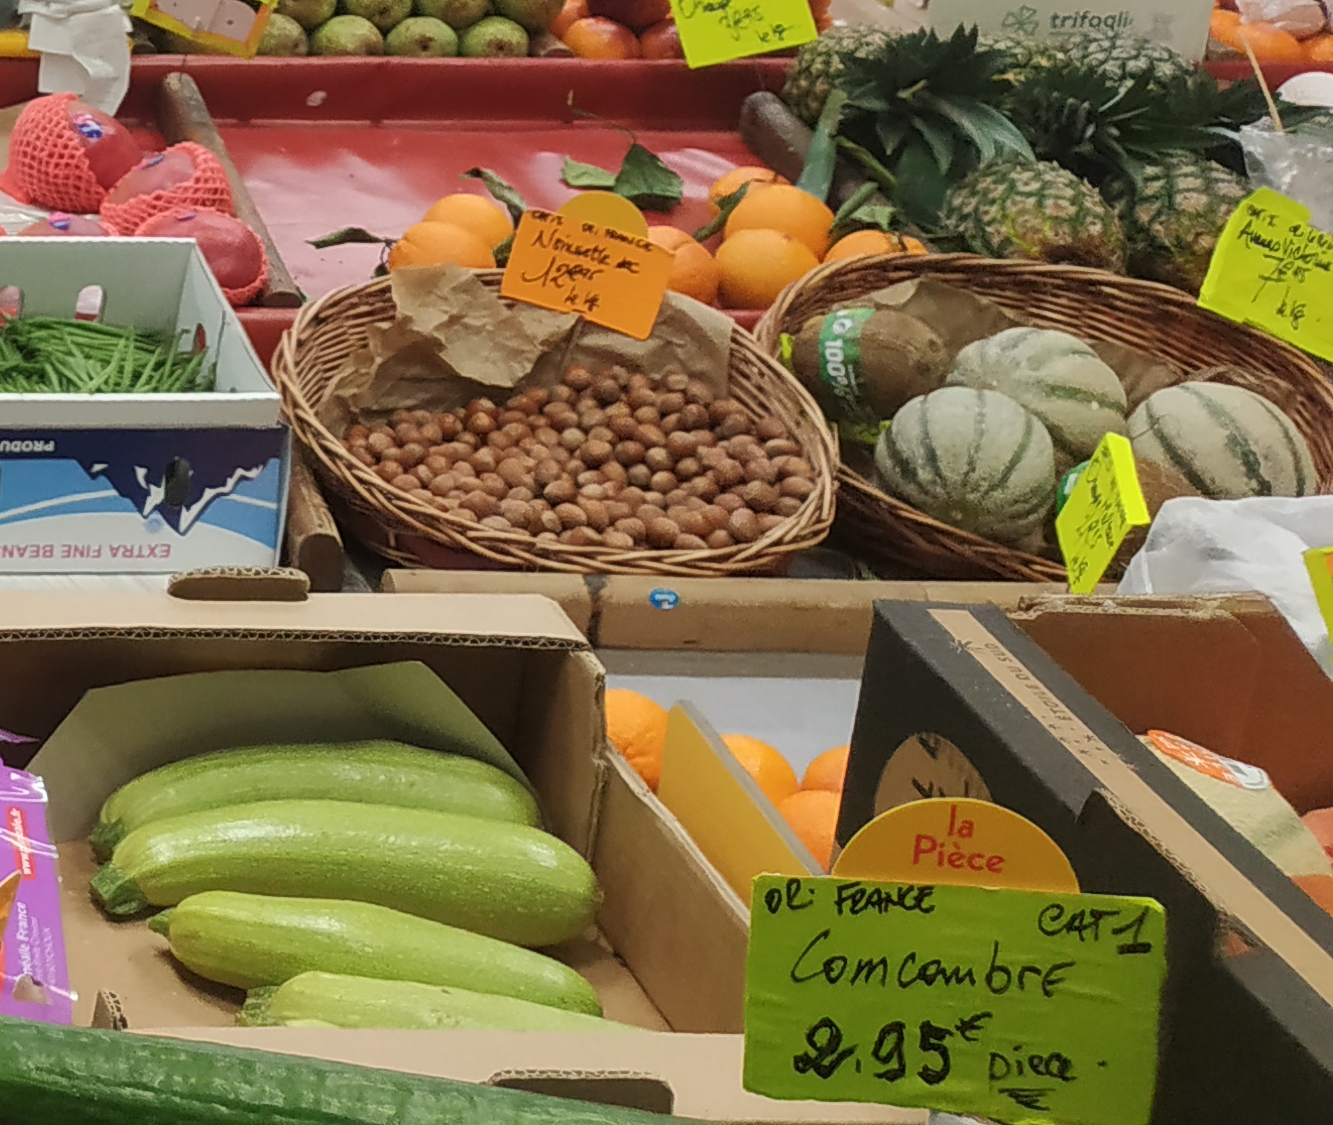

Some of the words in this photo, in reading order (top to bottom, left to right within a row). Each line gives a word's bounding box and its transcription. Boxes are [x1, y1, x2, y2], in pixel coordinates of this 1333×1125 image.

[60, 543, 103, 559] FINE
[109, 543, 171, 559] EXTRA
[947, 804, 975, 838] la
[912, 833, 1006, 874] Pièce
[833, 881, 938, 916] FRANCE
